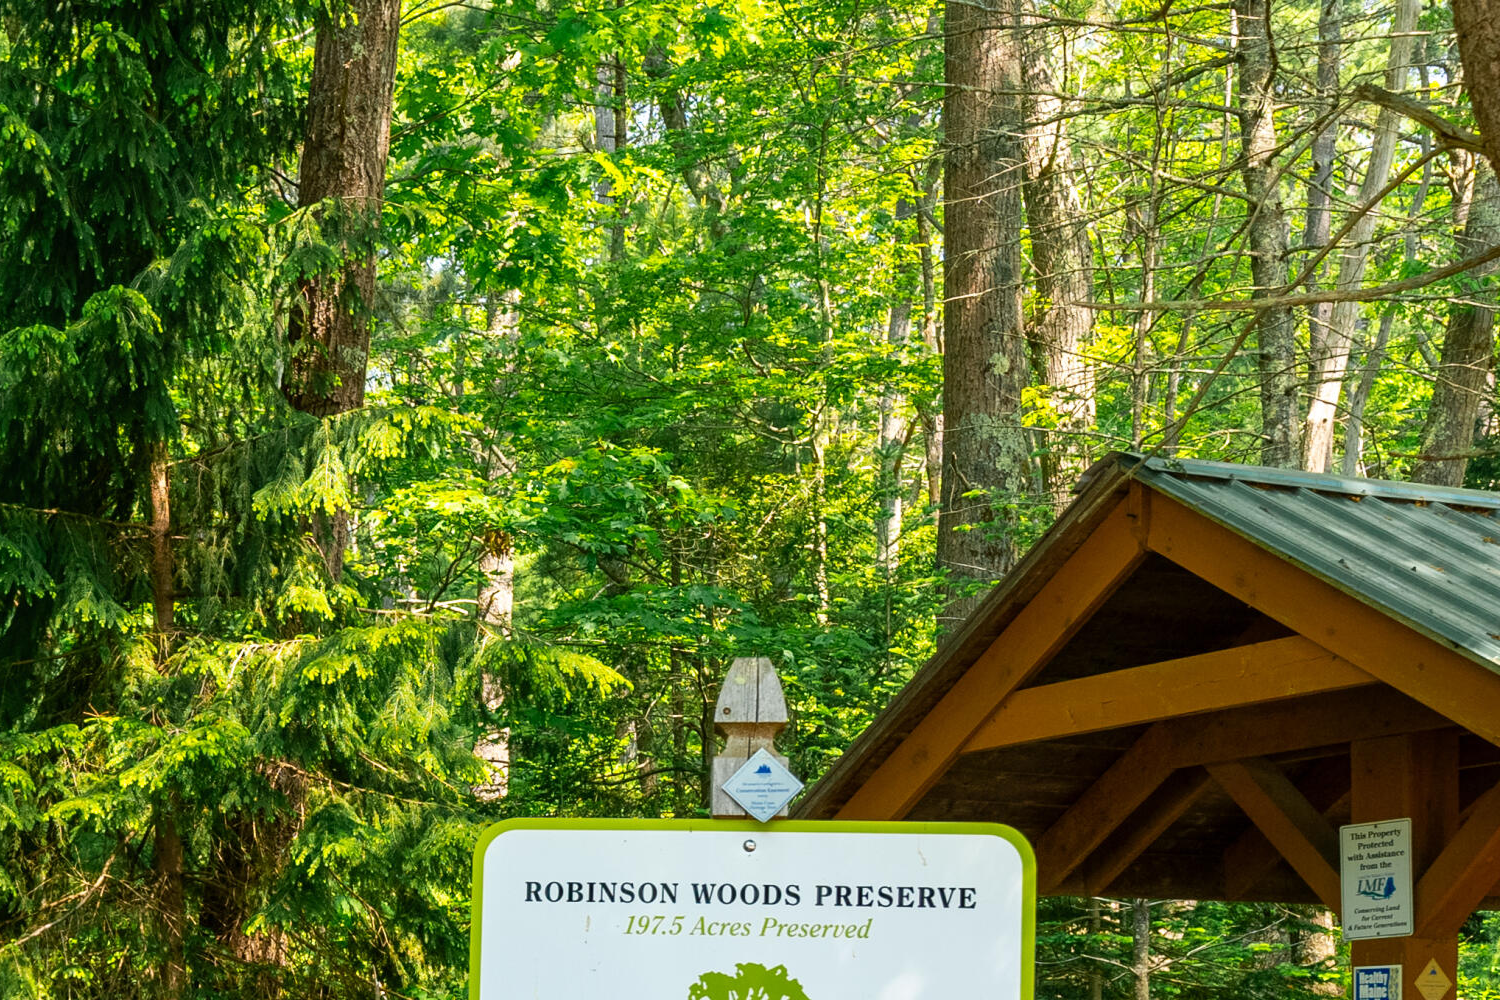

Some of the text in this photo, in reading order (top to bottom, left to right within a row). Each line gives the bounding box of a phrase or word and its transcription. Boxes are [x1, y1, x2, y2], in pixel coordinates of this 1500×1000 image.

[1351, 828, 1401, 840] This Property
[1358, 839, 1394, 850] Protected
[1347, 849, 1405, 861] with Assistance
[1359, 861, 1392, 871] from the
[1357, 877, 1386, 896] LMF
[525, 881, 978, 910] ROBINSON WOODS PRESERVE
[1354, 904, 1400, 914] Conserving Land
[1371, 913, 1393, 921] Current
[623, 915, 874, 940] 197.5 Acres Preserved
[1354, 923, 1372, 931] Future
[1373, 921, 1407, 930] Generations
[1358, 971, 1388, 986] Healthy
[1359, 984, 1387, 999] Maine
